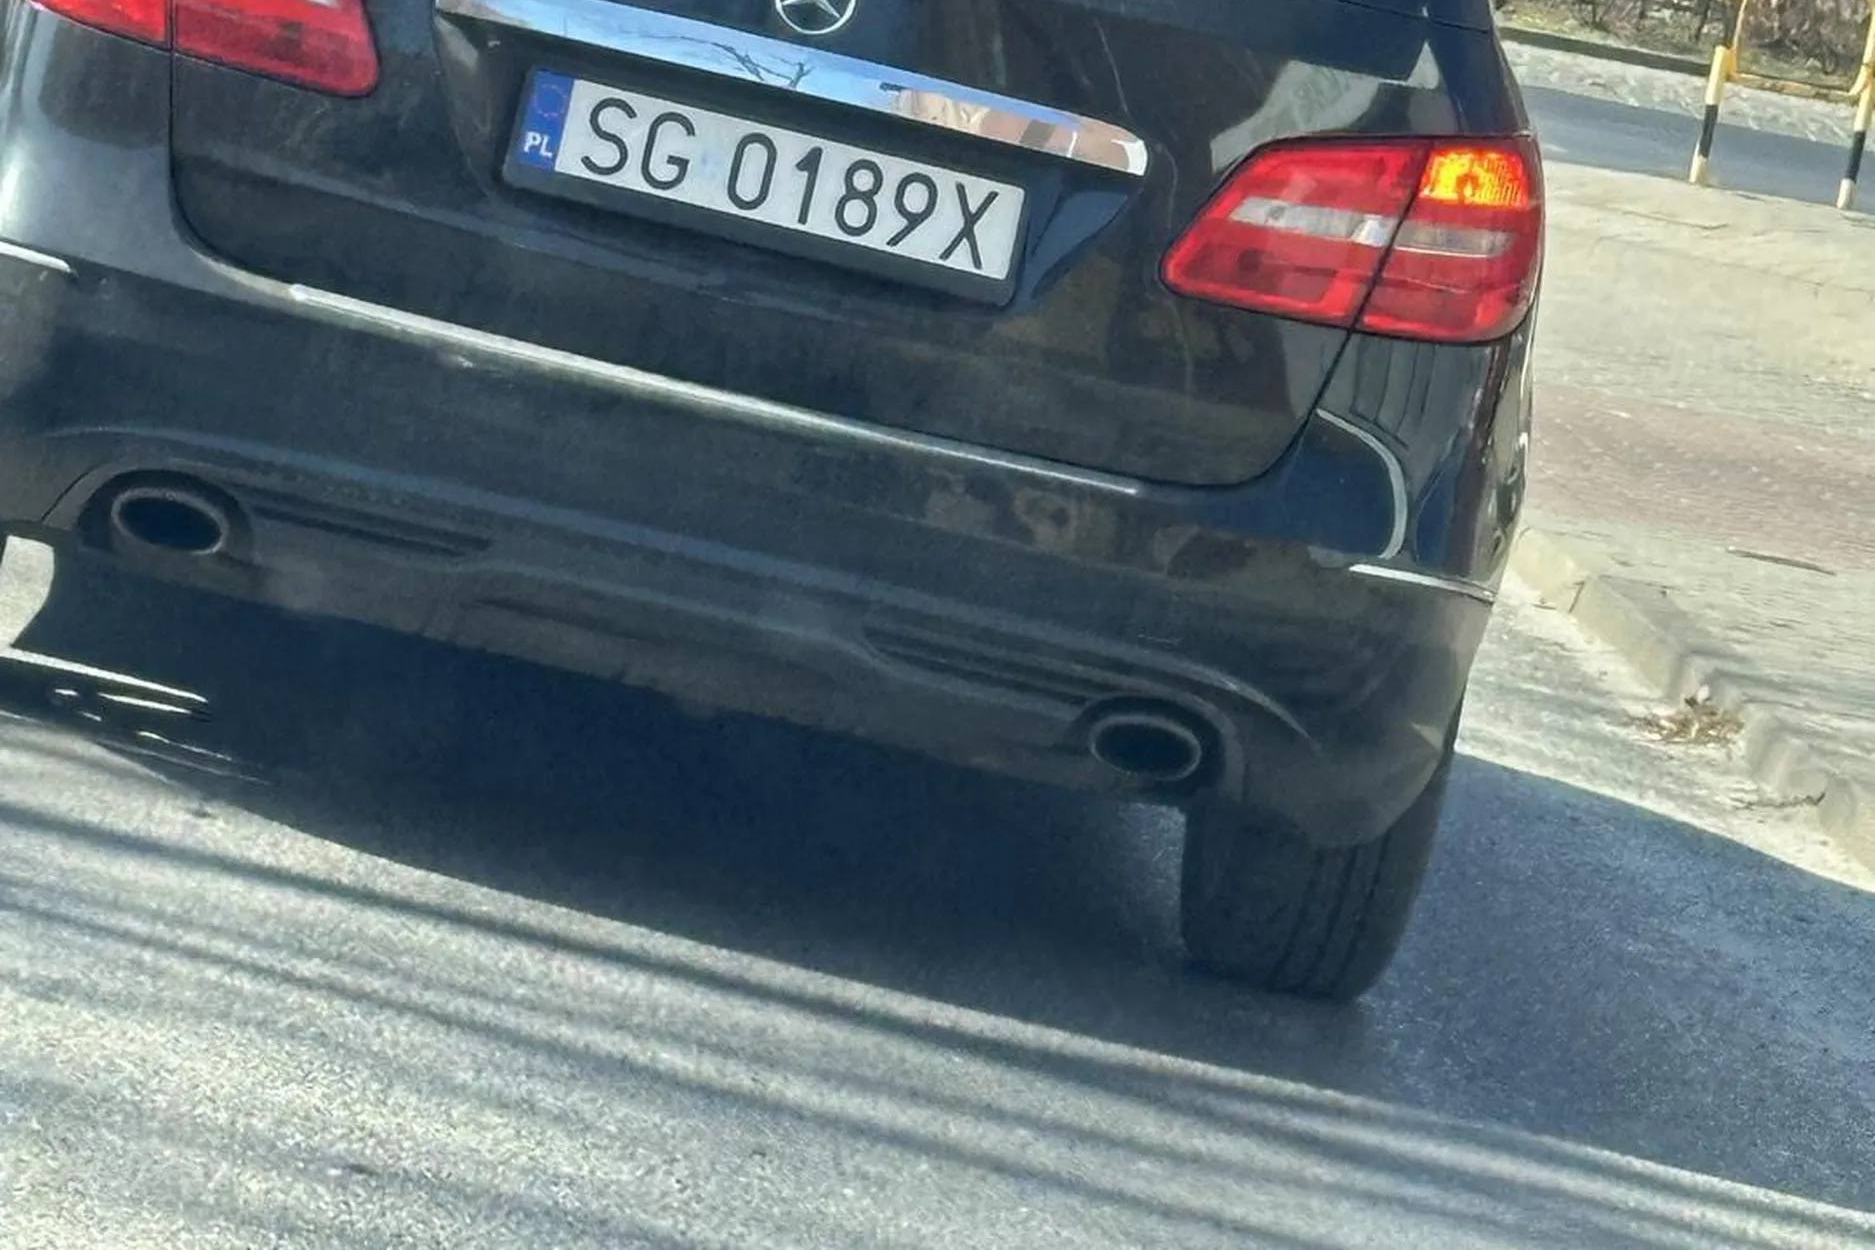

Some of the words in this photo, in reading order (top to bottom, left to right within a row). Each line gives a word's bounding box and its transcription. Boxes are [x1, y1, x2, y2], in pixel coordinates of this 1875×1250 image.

[523, 131, 553, 158] PL
[580, 97, 696, 191] SG
[726, 132, 999, 269] 0189X
